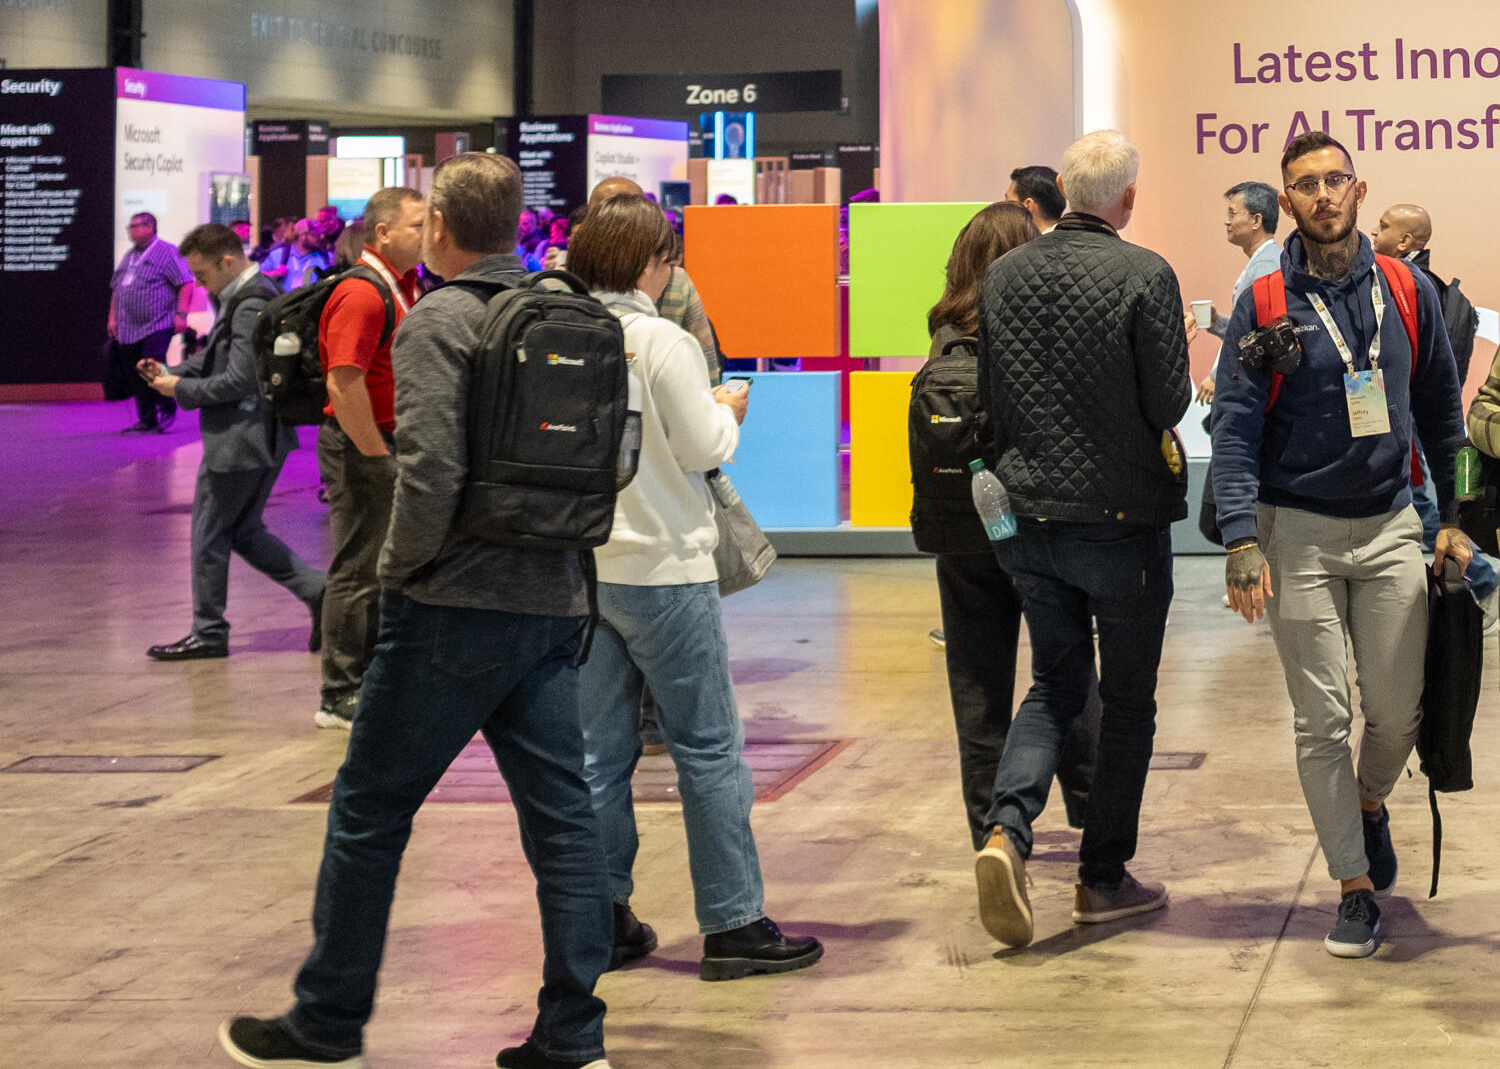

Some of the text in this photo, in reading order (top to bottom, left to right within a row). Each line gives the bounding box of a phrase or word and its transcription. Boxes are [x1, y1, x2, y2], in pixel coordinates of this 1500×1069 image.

[1232, 42, 1380, 84] Latest
[1, 78, 62, 97] Security
[686, 84, 757, 105] Zone 6
[0, 123, 55, 136] Meet with
[124, 123, 161, 143] Microsoft
[519, 122, 558, 133] Business
[1196, 112, 1269, 154] For
[0, 136, 42, 149] experts
[519, 132, 575, 144] Applications
[124, 152, 184, 176] Security Copilot
[1352, 409, 1369, 417] Jeffrey
